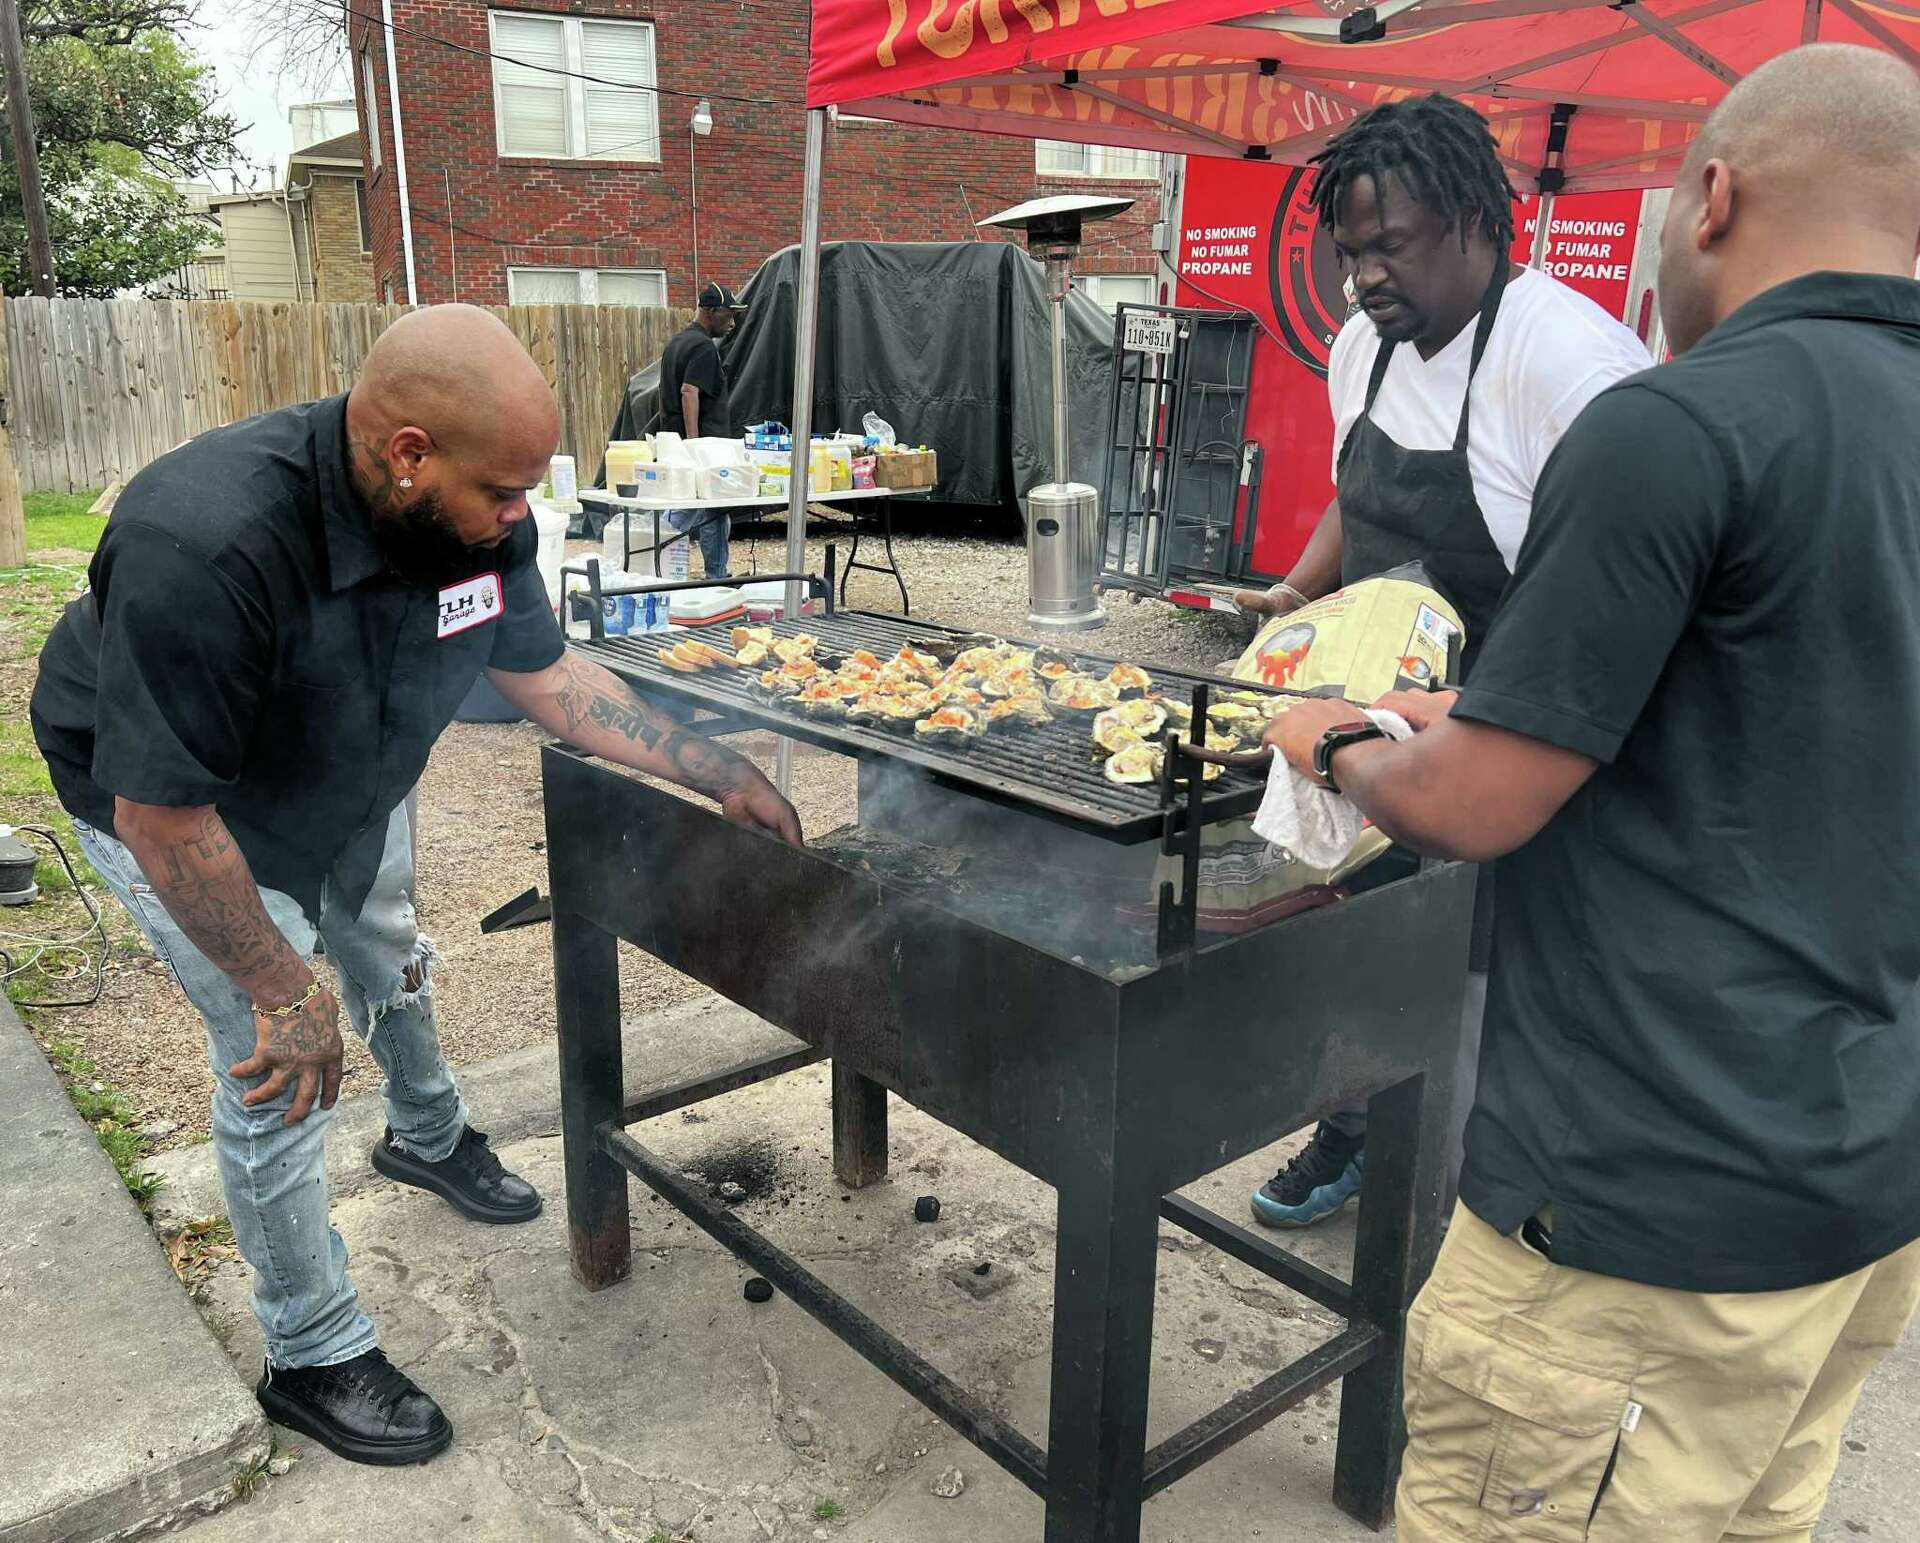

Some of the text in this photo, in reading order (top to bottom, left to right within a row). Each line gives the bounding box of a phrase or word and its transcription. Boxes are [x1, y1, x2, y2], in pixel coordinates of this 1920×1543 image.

[1186, 226, 1256, 241] NO SMOKING
[1551, 219, 1625, 237] SMOKING
[1191, 244, 1248, 258] NO FUMAR
[1555, 241, 1611, 258] FUMAR
[1182, 262, 1252, 275] PROPANE
[1540, 261, 1628, 280] ROPANE
[1140, 318, 1160, 326] TEXAS
